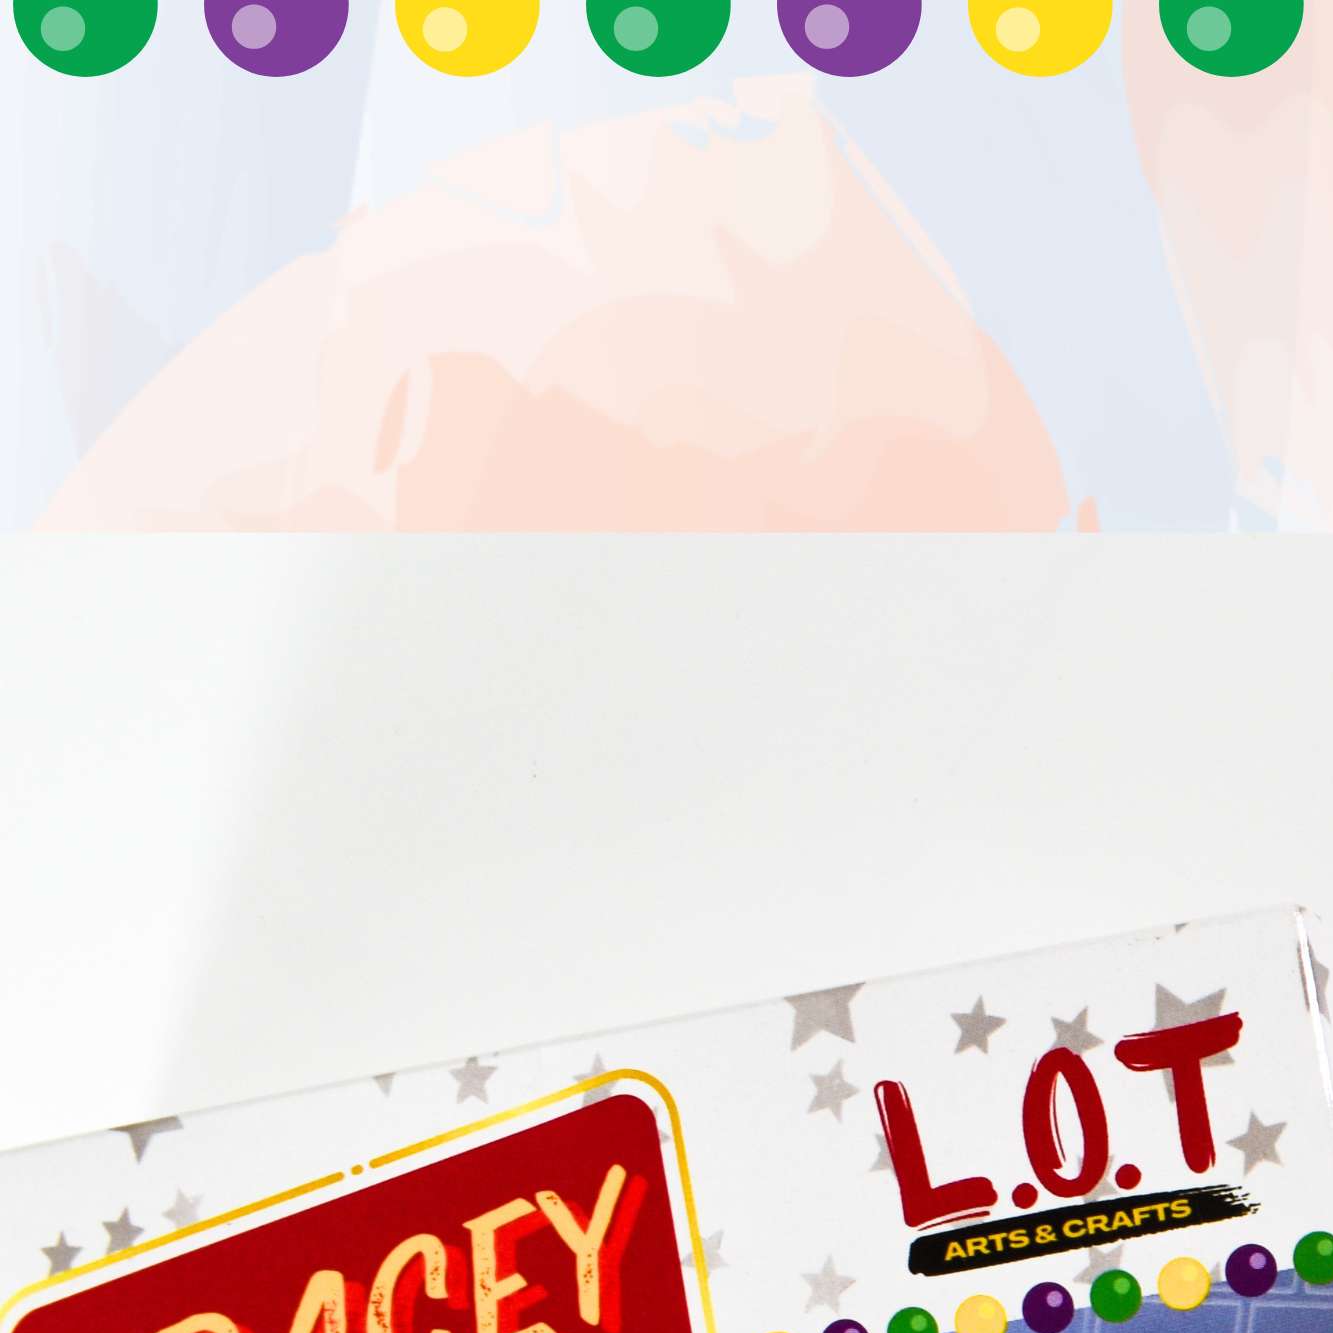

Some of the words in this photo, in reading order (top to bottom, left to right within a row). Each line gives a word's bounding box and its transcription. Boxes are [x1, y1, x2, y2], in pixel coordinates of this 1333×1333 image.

[873, 1011, 1243, 1230] L.O.T
[943, 1228, 1030, 1262] ARTS
[1034, 1223, 1058, 1244] &
[1061, 1198, 1191, 1239] CRAFTS
